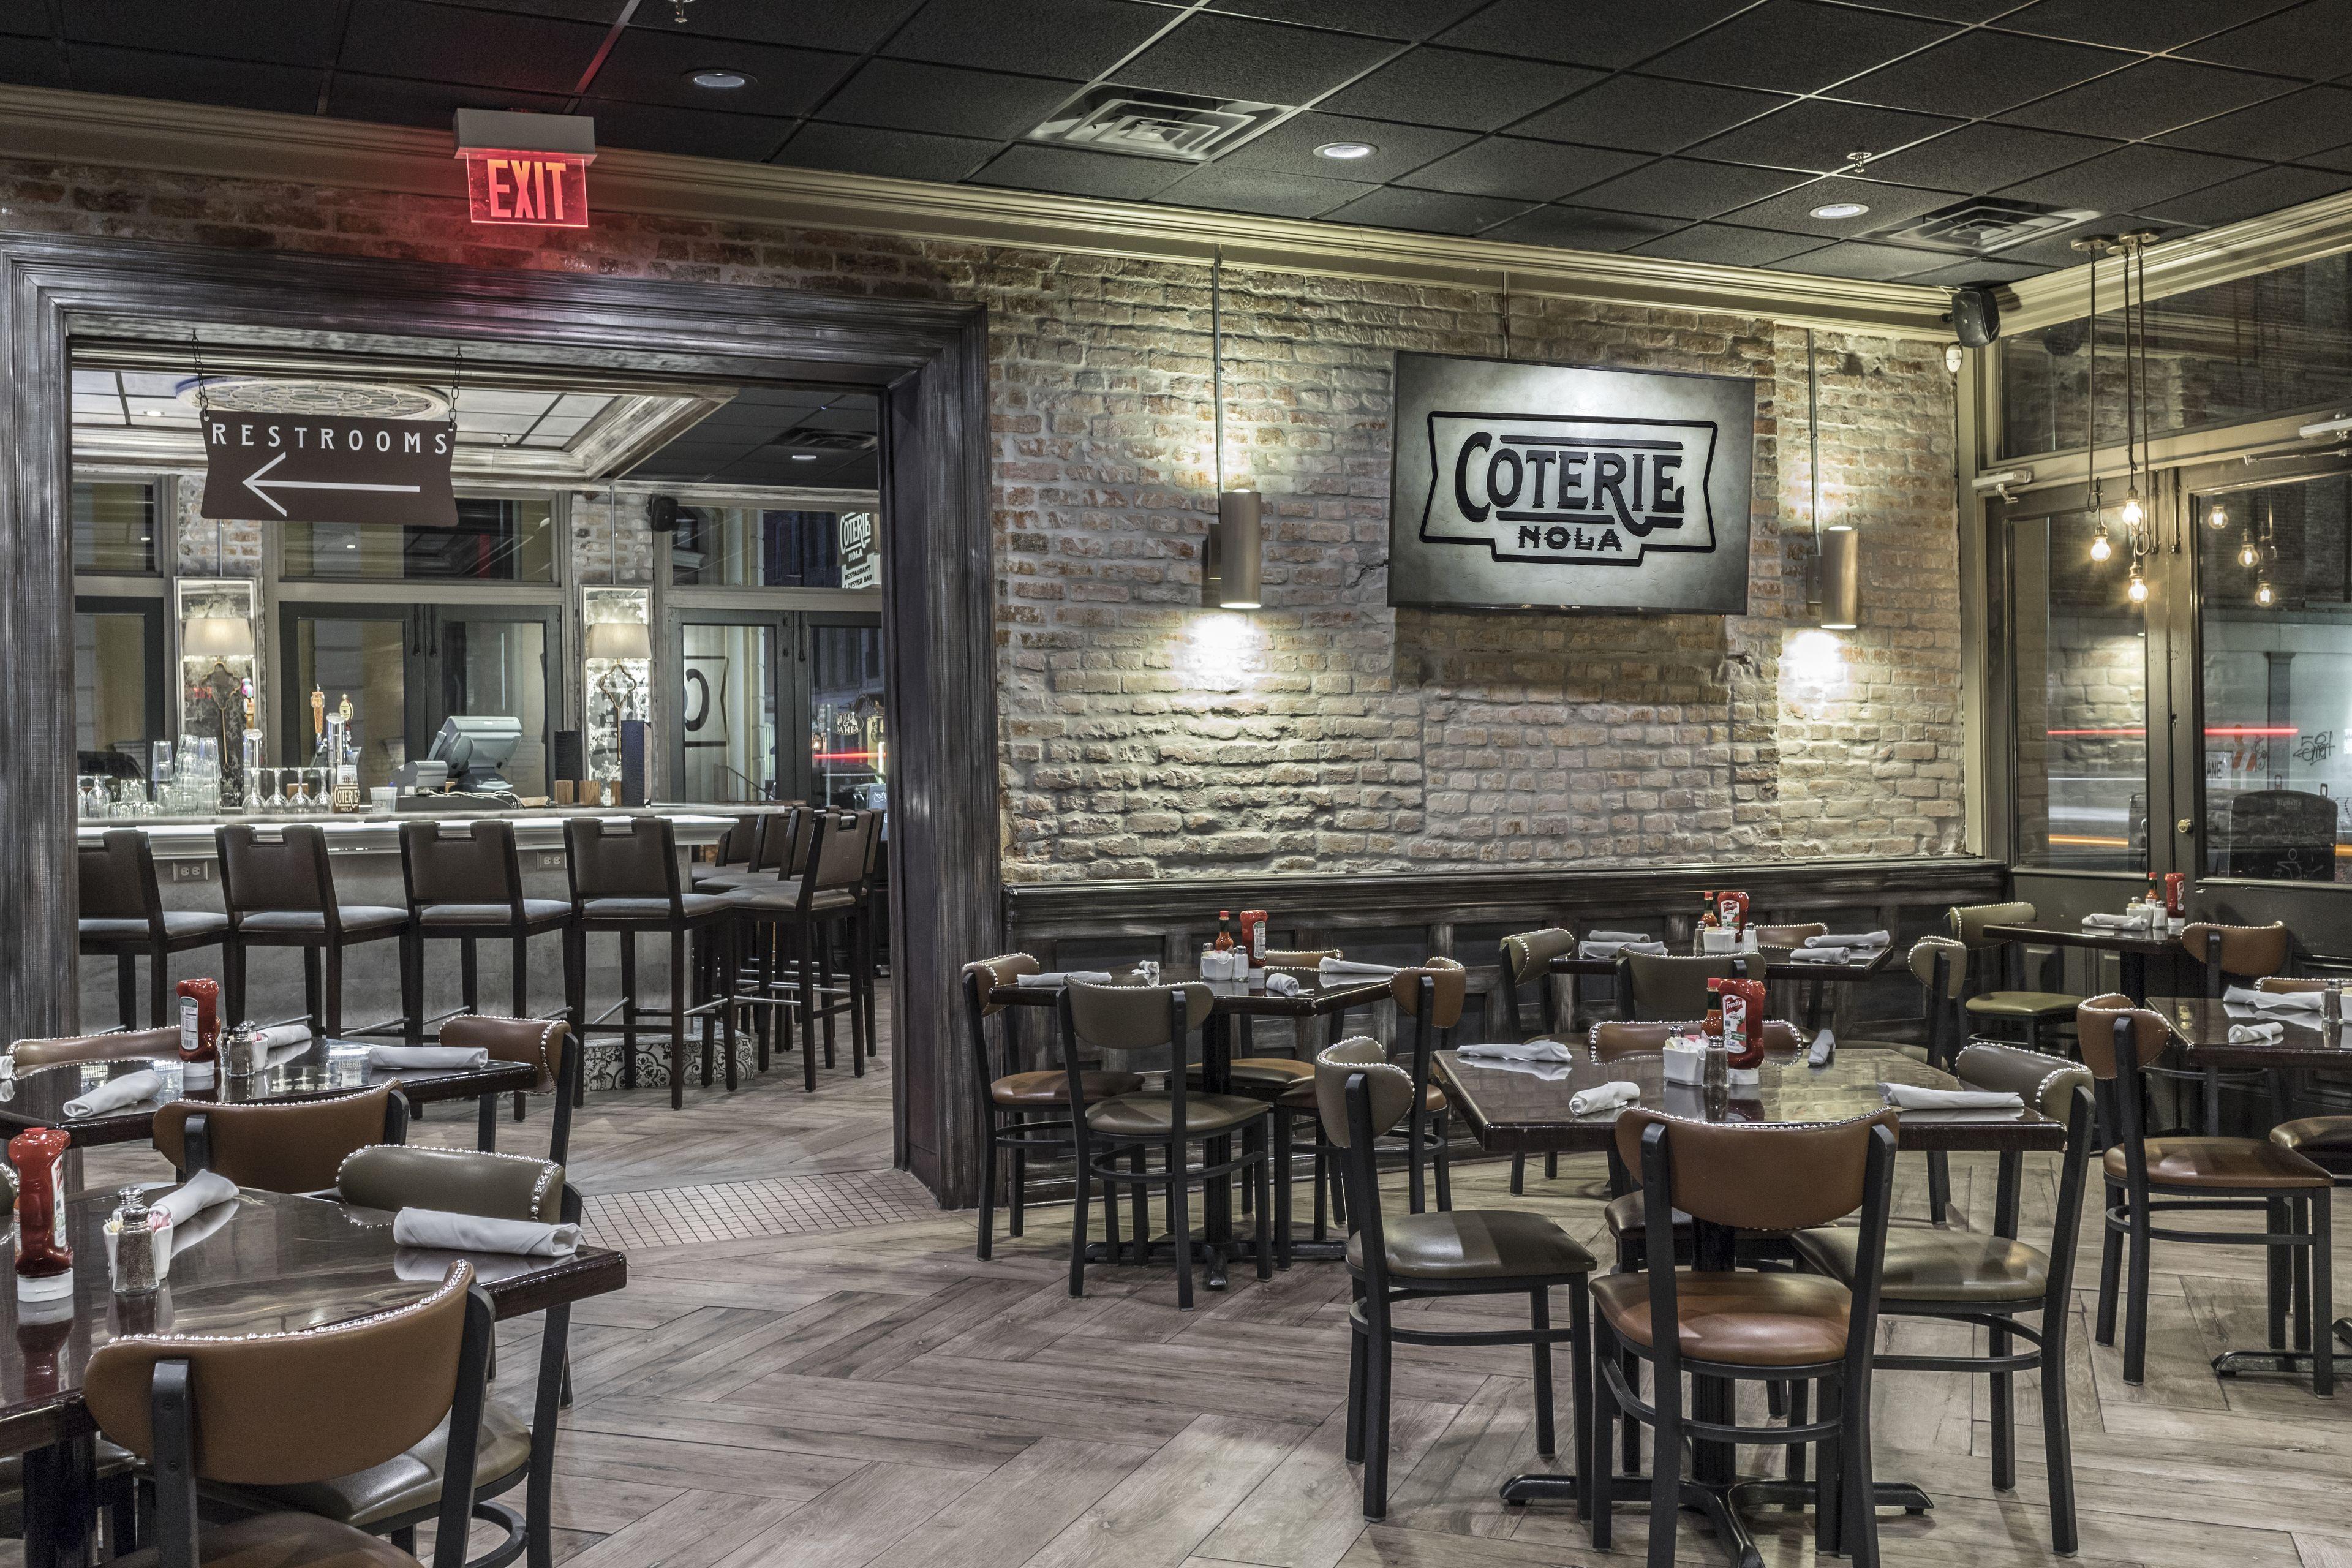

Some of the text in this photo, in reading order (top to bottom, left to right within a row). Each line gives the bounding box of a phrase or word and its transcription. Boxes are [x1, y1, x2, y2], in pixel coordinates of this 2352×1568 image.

[487, 159, 566, 220] EXIT
[212, 423, 447, 455] RESTROOMS
[1454, 431, 1686, 537] COTERIE
[840, 513, 871, 555] COTERIE
[1518, 525, 1623, 552] NOLA
[848, 548, 863, 562] NOLA
[845, 564, 871, 581] RESTAURANT
[864, 574, 873, 582] BAR
[334, 786, 359, 809] COTERIE
